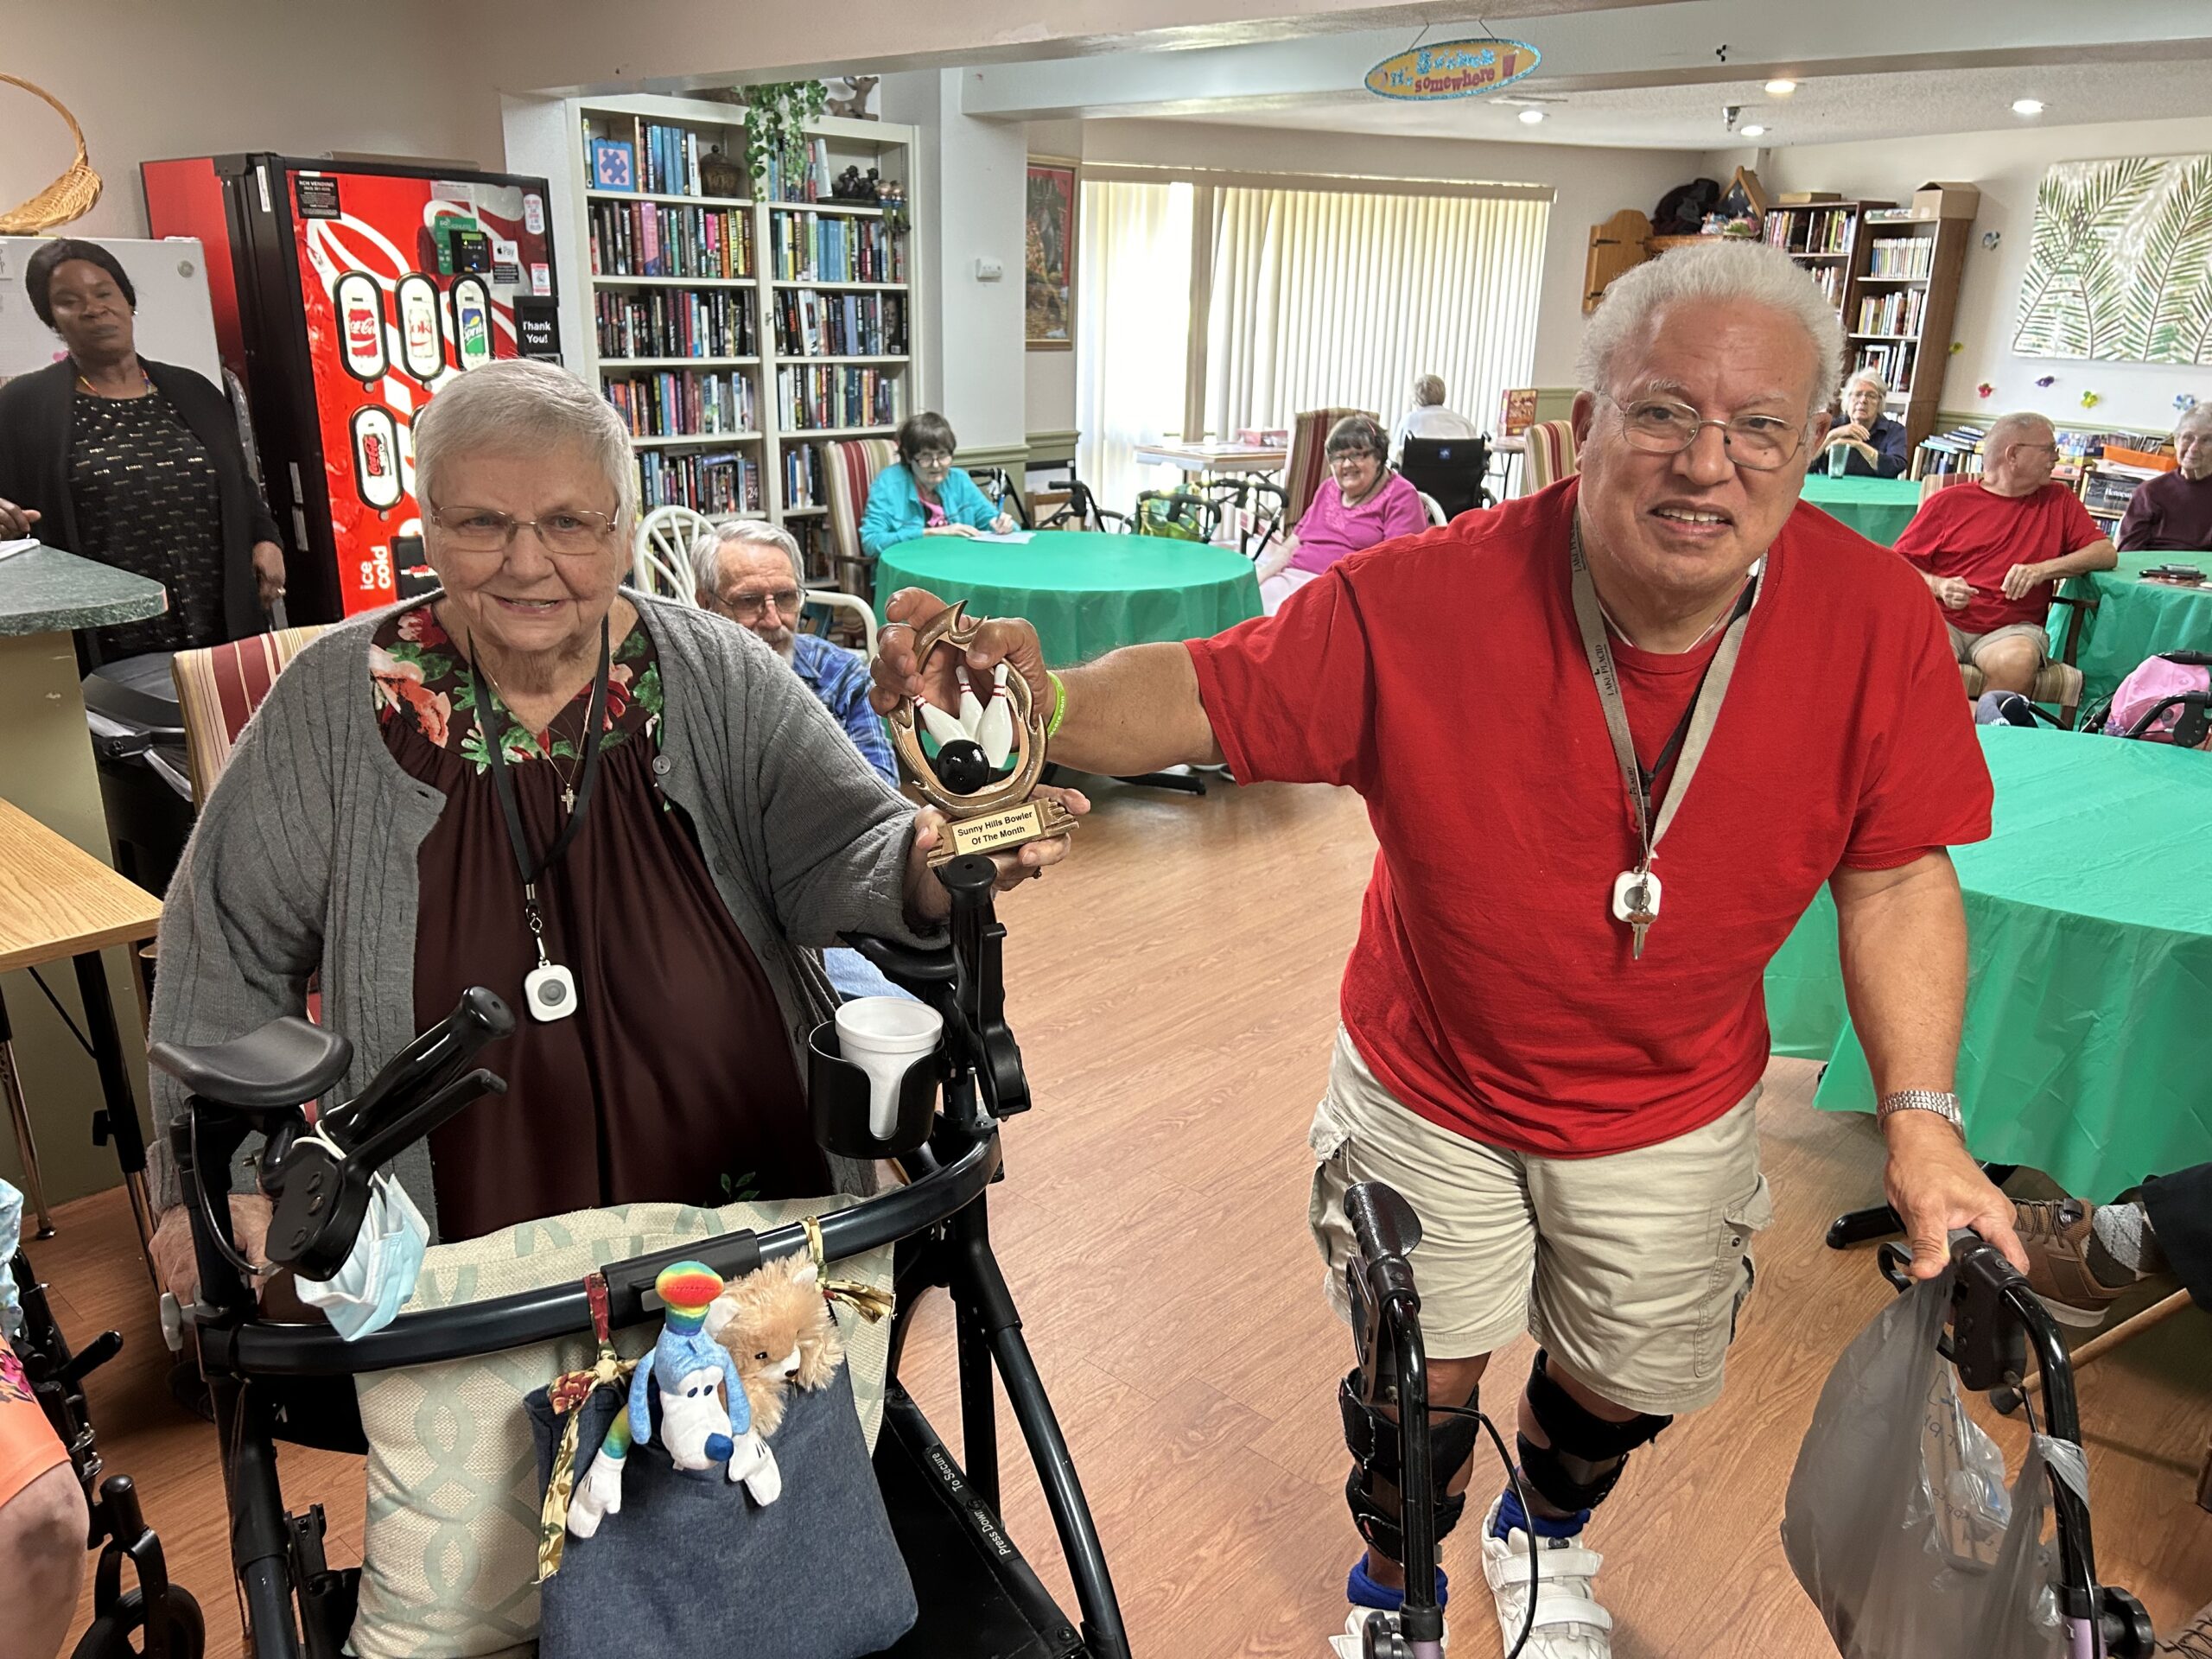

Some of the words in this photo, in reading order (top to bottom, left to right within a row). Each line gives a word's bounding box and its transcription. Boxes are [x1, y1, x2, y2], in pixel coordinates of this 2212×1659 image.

[1415, 68, 1496, 92] somewhere
[503, 246, 514, 257] Pay
[523, 321, 551, 331] Thank
[526, 334, 549, 344] You!
[360, 561, 375, 590] ice
[371, 545, 391, 589] cold
[1595, 644, 1609, 673] PLACID
[1604, 677, 1615, 696] LAKE
[957, 824, 983, 836] Sunny
[984, 819, 1003, 830] Hills
[1004, 811, 1033, 824] Bowler
[971, 836, 982, 845] Of
[999, 826, 1026, 838] Month
[931, 1452, 956, 1481] Secure
[951, 1479, 964, 1492] To
[974, 1509, 994, 1533] Down
[988, 1531, 1012, 1555] Press
